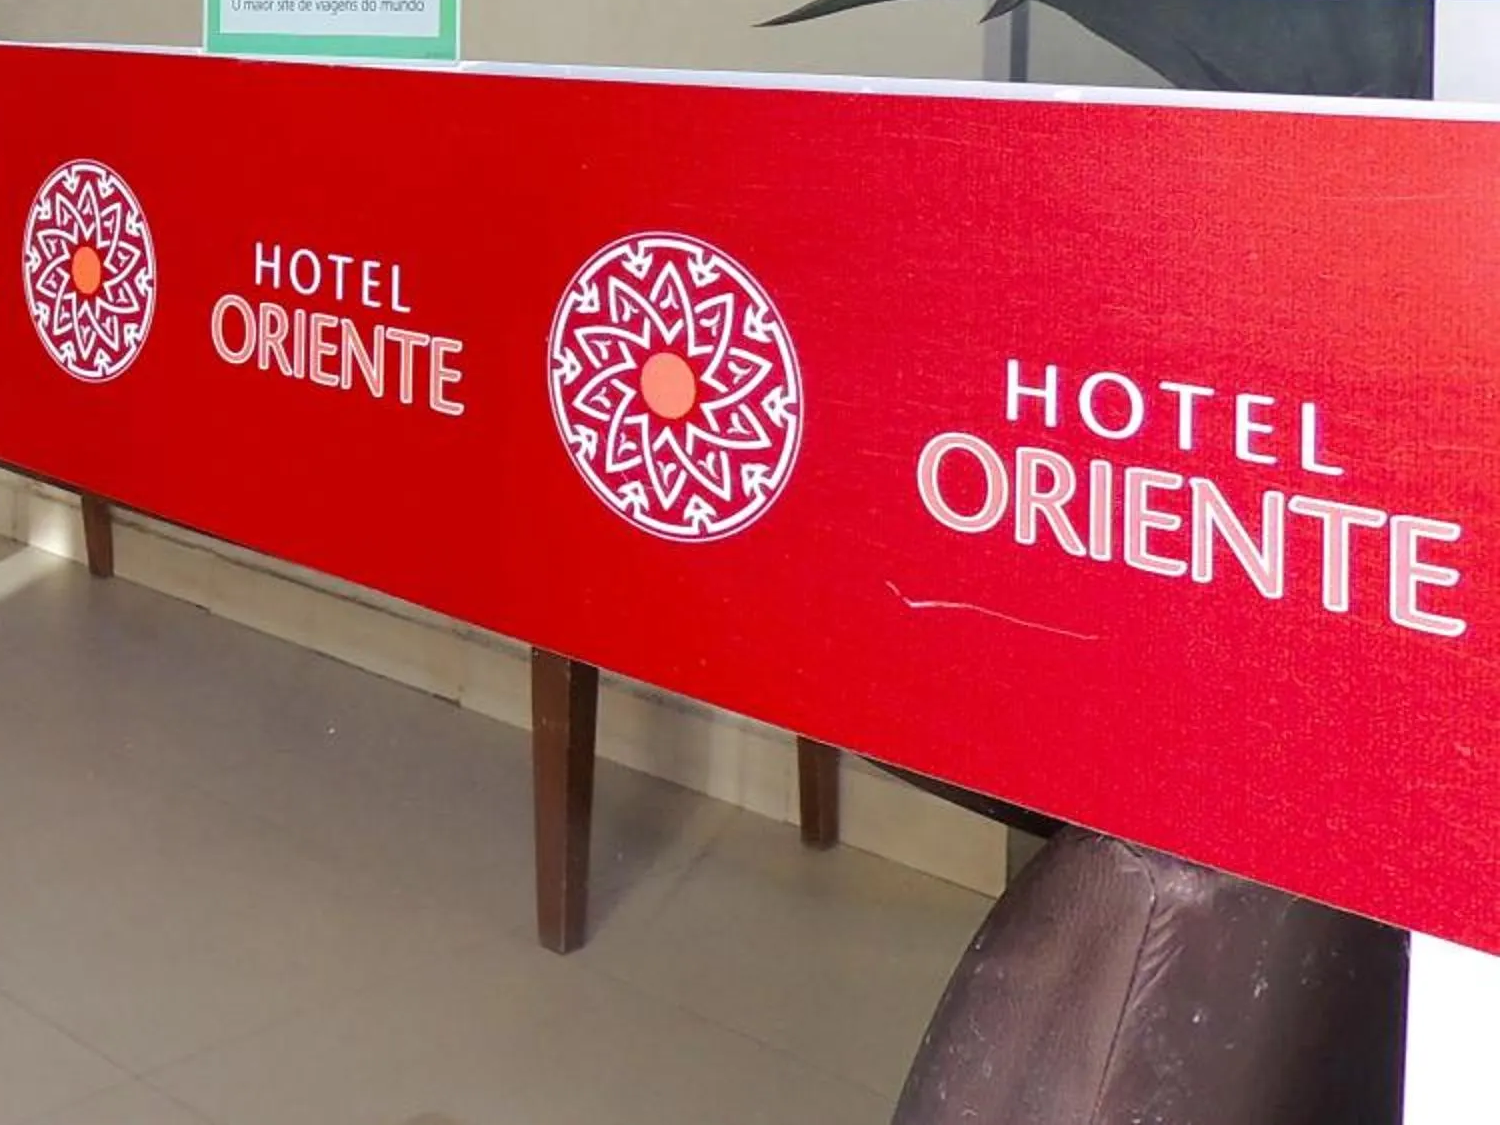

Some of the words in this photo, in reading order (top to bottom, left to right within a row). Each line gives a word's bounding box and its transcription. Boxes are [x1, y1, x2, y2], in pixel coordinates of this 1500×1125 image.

[254, 241, 412, 313] HOTEL
[210, 293, 466, 416] ORIENTE
[1005, 358, 1345, 476] HOTEL
[915, 431, 1468, 638] ORIENTE
